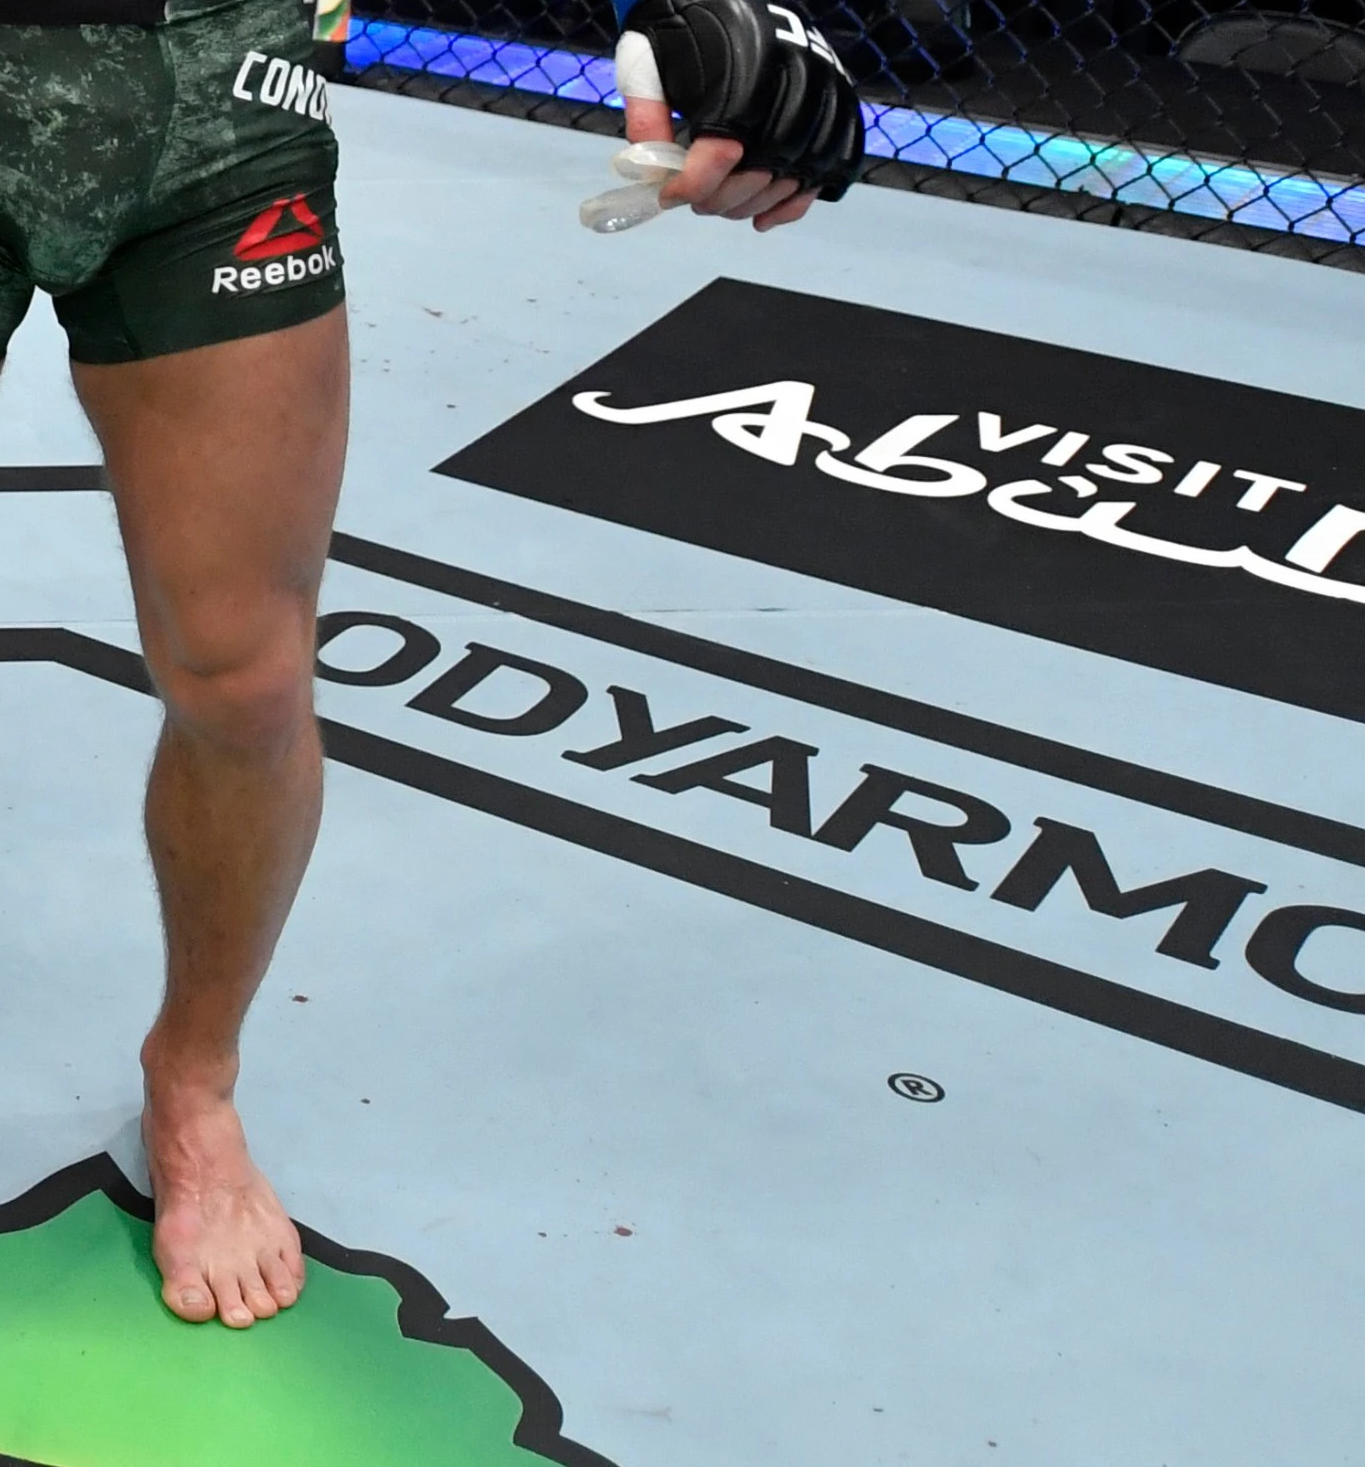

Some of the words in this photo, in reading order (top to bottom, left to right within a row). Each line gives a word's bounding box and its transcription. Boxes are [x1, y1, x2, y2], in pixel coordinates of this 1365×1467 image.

[233, 51, 332, 126] CONO
[211, 245, 336, 294] Reebok
[978, 411, 1307, 513] VISIT
[316, 611, 1365, 1015] ODYARMO
